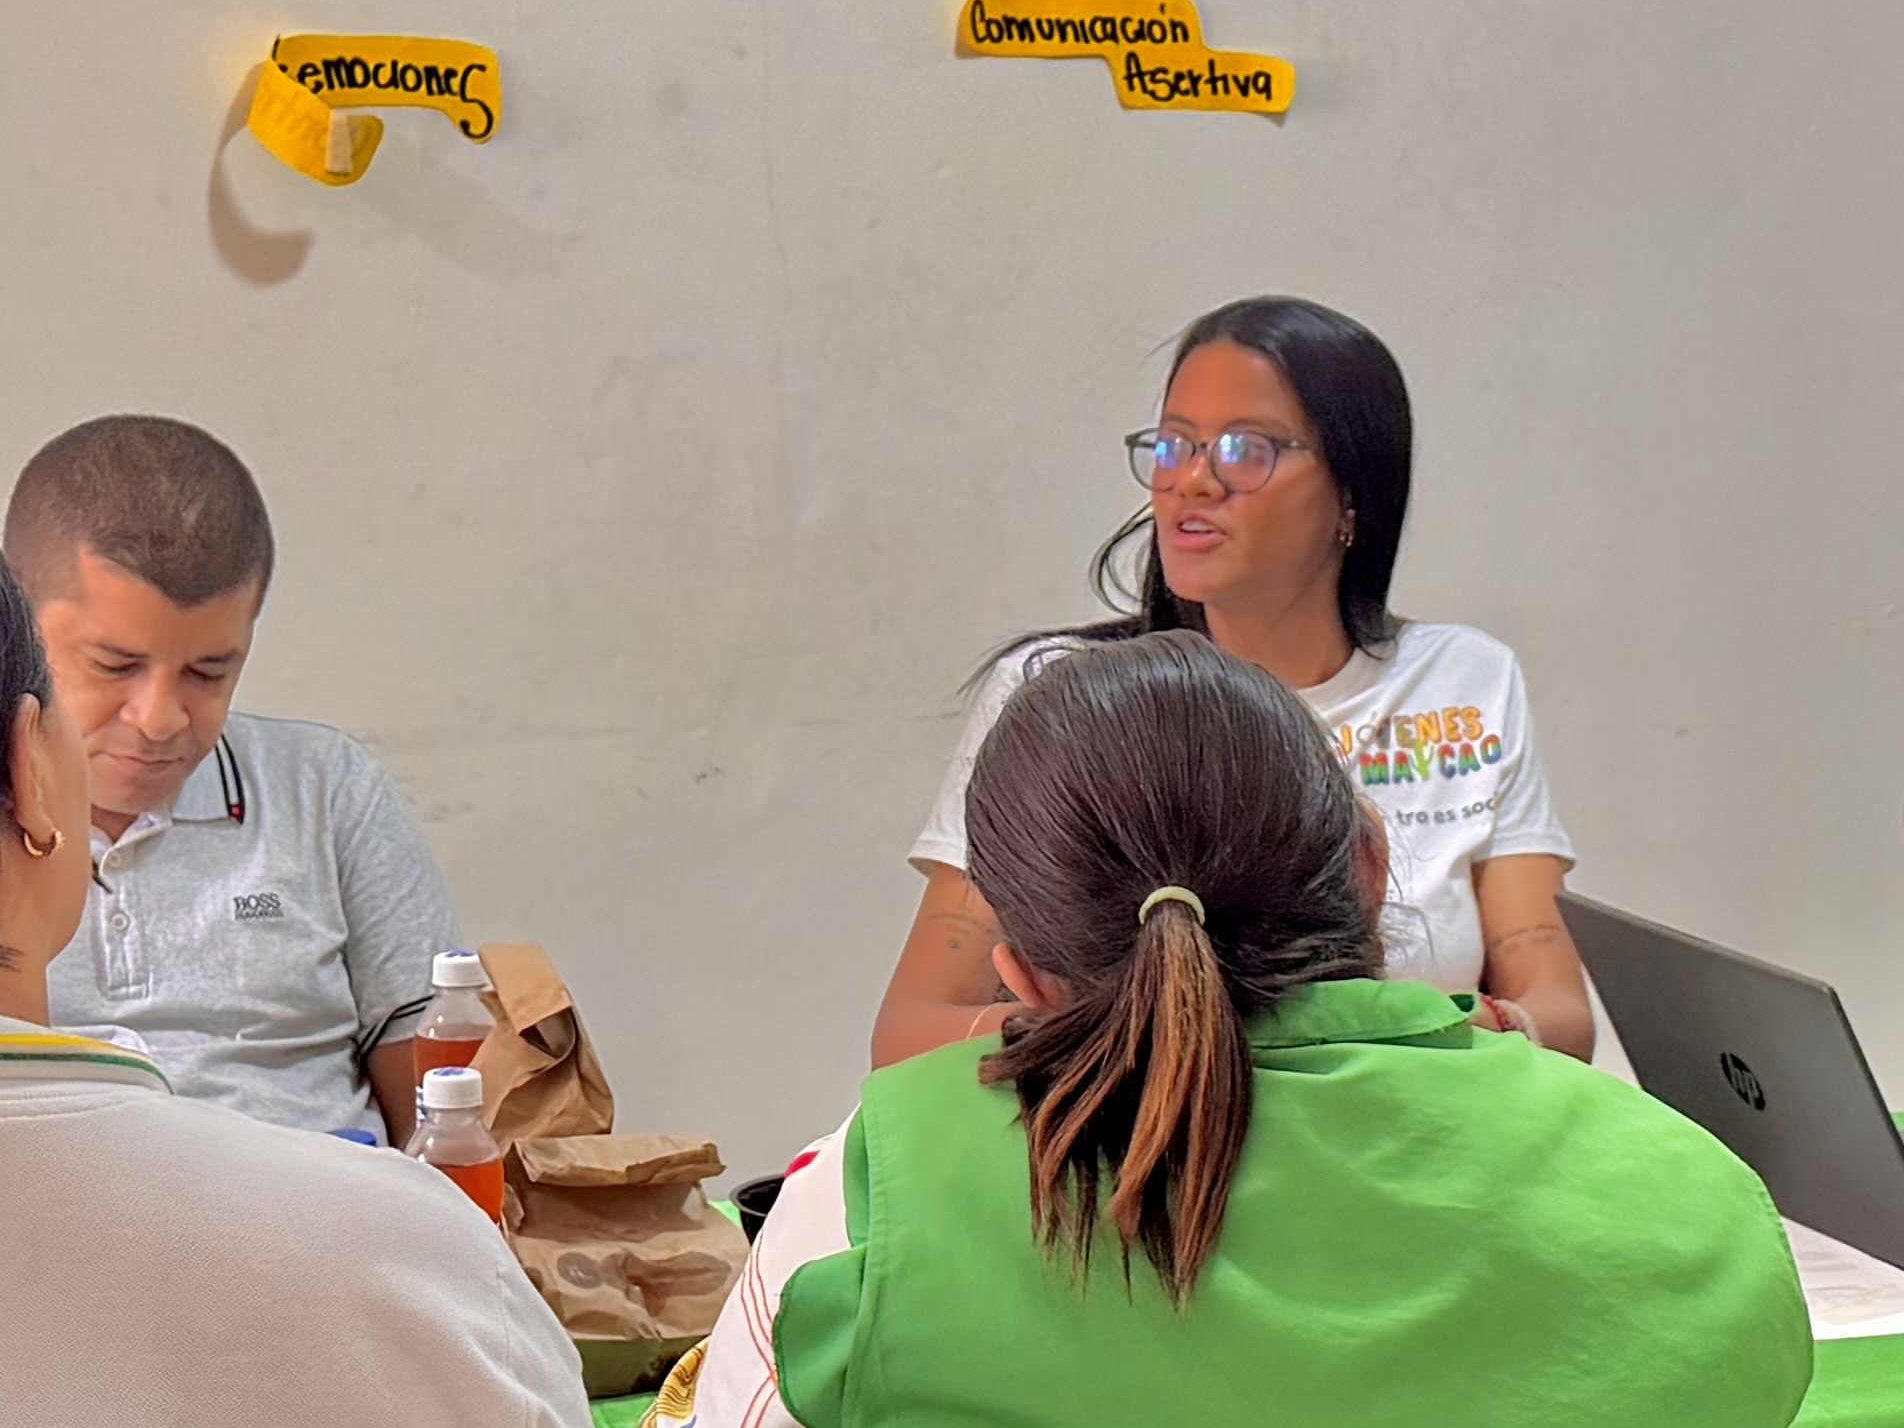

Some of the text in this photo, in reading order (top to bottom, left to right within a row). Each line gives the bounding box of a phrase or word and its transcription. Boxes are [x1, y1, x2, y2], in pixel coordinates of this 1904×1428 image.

[1122, 51, 1273, 102] Asertiva
[1433, 807, 1457, 822] es
[1461, 796, 1497, 819] soc
[232, 892, 281, 911] BOSS
